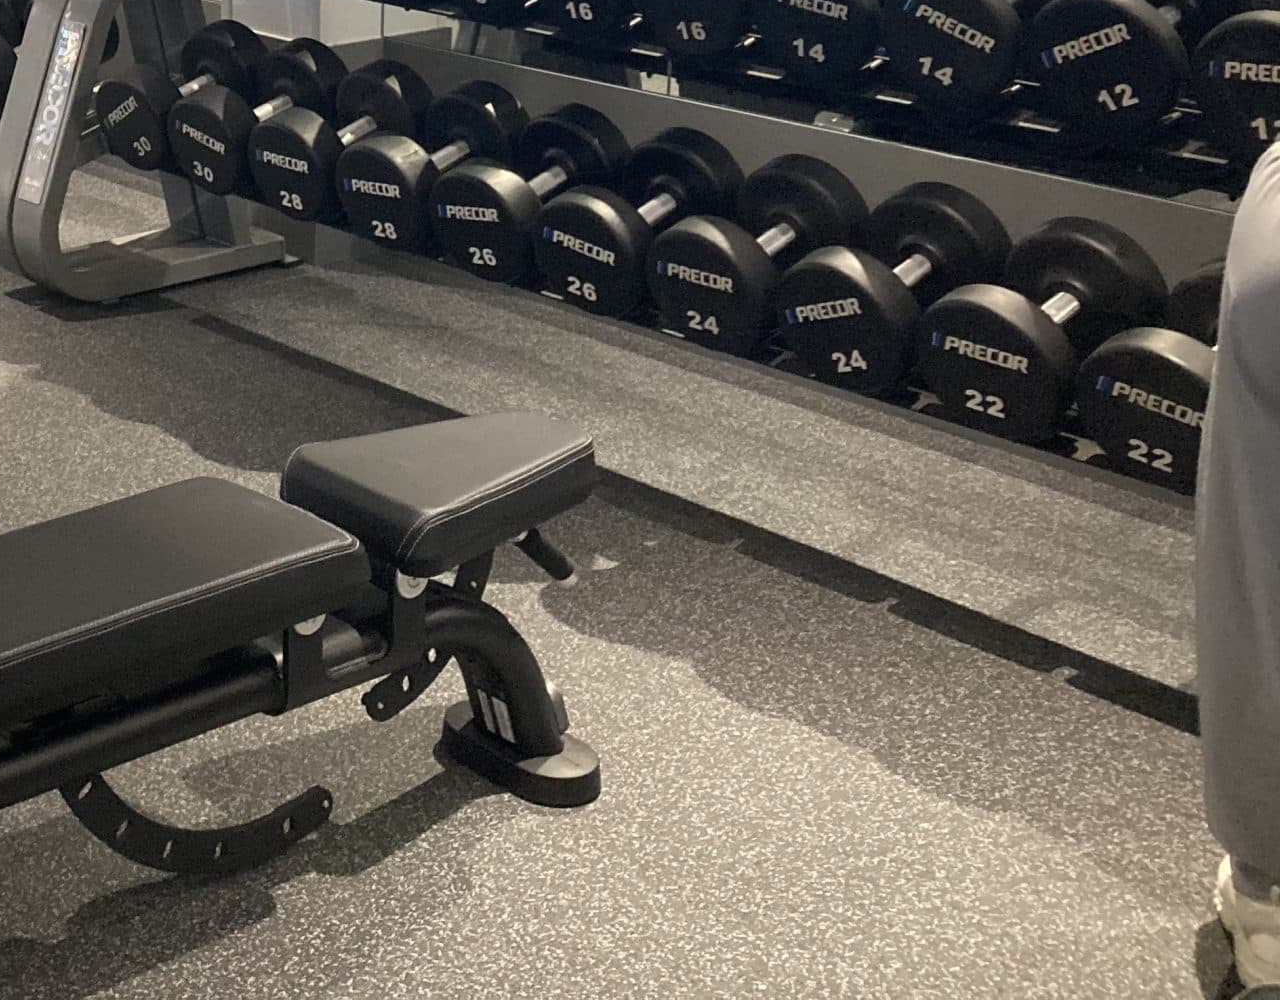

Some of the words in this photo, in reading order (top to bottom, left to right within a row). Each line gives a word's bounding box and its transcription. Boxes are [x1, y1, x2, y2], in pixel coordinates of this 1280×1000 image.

[565, 1, 593, 21] 16
[676, 21, 707, 41] 16
[915, 4, 995, 53] PRECOR
[792, 38, 825, 63] 14
[1052, 23, 1132, 64] PRECOR
[918, 56, 953, 86] 14
[1224, 61, 1280, 84] PREC
[1097, 83, 1140, 112] 12
[108, 96, 138, 126] PRECOR
[133, 136, 151, 157] 30
[182, 123, 225, 155] PRECOR
[193, 161, 214, 182] 30
[263, 150, 309, 174] PRECOR
[280, 191, 303, 211] 28
[351, 179, 401, 199] PRECOR
[446, 205, 500, 222] PRECOR
[371, 220, 397, 240] 28
[469, 247, 497, 266] 26
[553, 230, 616, 267] PRECOR
[567, 276, 597, 302] 26
[667, 263, 734, 293] PRECOR
[687, 310, 720, 335] 24
[795, 298, 862, 322] PRECOR
[832, 350, 867, 373] 24
[944, 336, 1029, 374] PRECOR
[964, 389, 1006, 419] 22
[1111, 381, 1205, 429] PRECOR
[1128, 438, 1173, 473] 22
